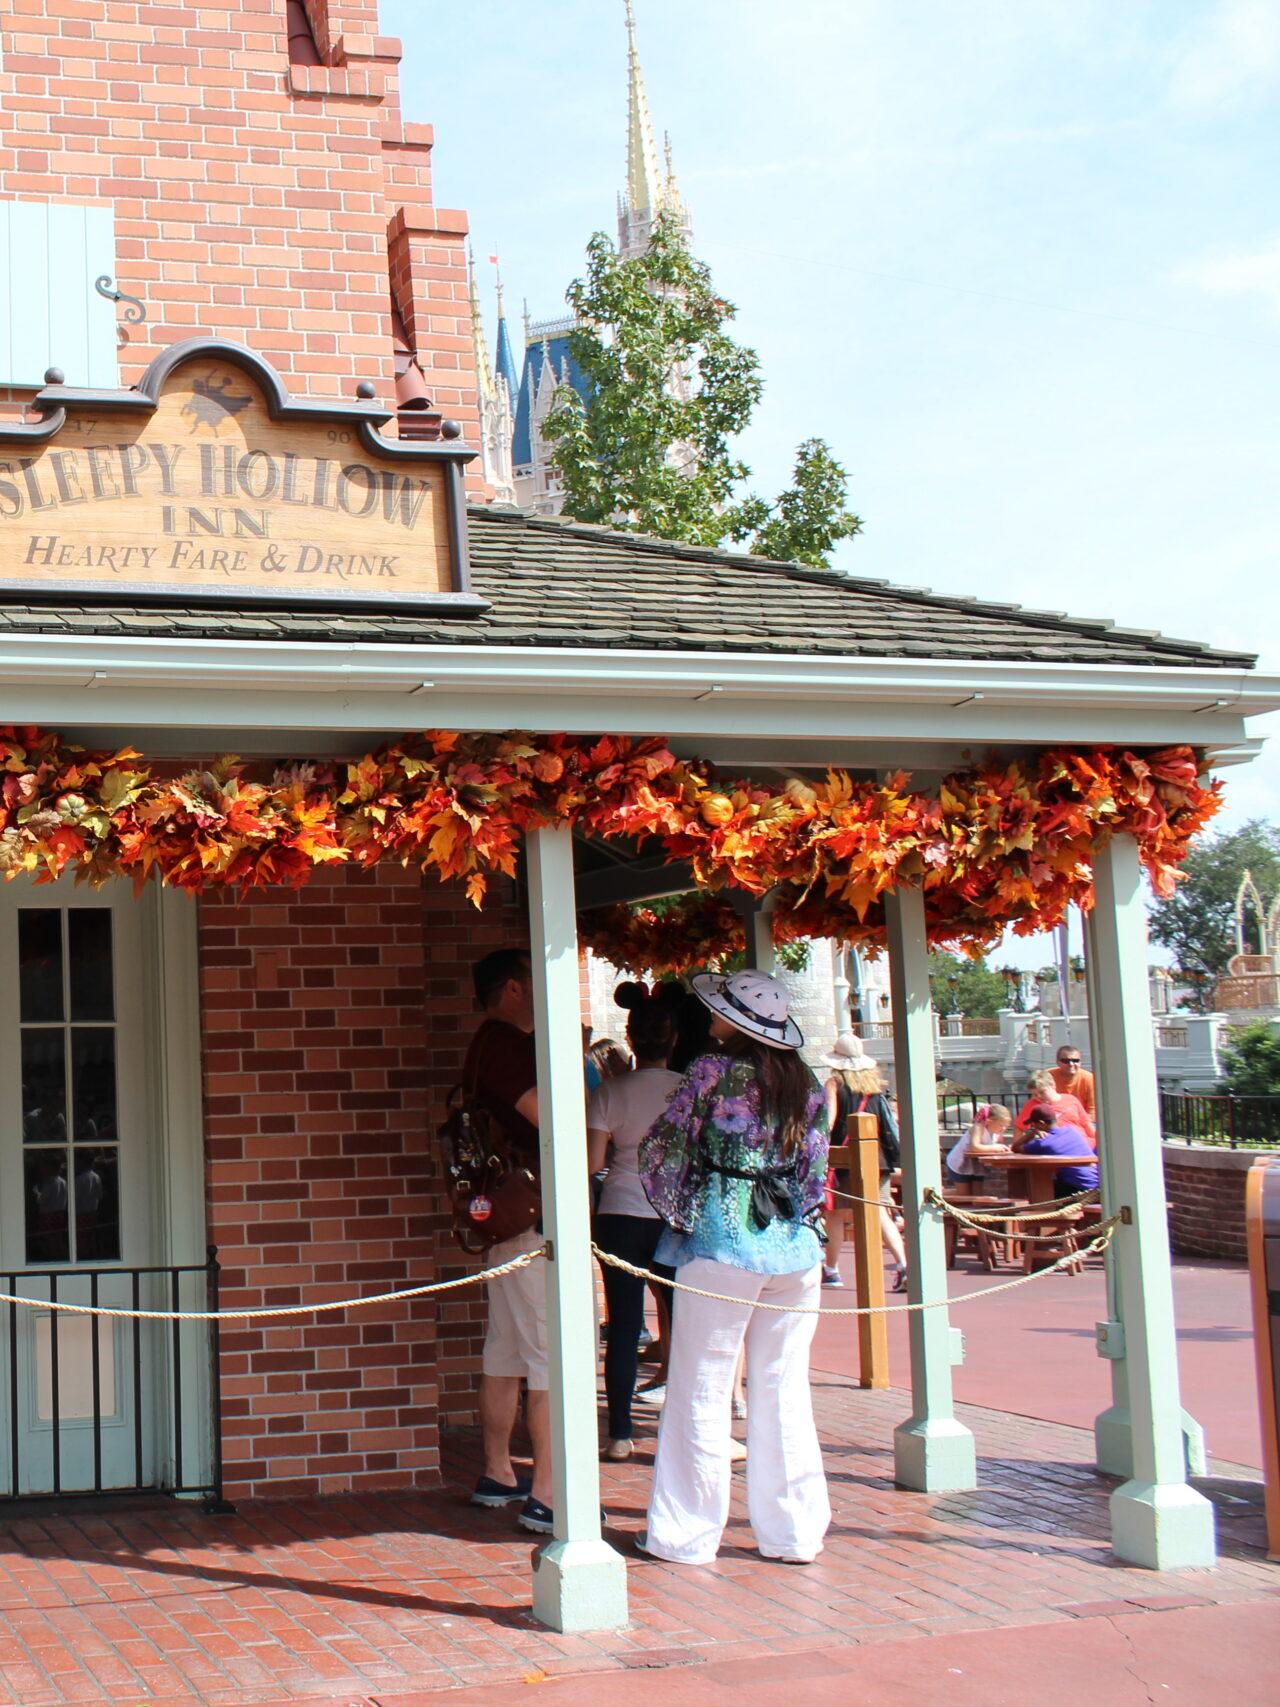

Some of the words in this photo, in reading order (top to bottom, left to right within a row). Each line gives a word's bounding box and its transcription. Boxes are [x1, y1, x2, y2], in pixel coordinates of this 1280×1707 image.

[72, 420, 97, 436] 17
[326, 430, 352, 447] 90
[197, 443, 433, 531] HOLLOW
[161, 505, 272, 539] INN
[23, 535, 160, 573] HEARTY
[167, 540, 249, 577] FARE
[259, 543, 289, 573] &
[294, 545, 401, 581] DRINK
